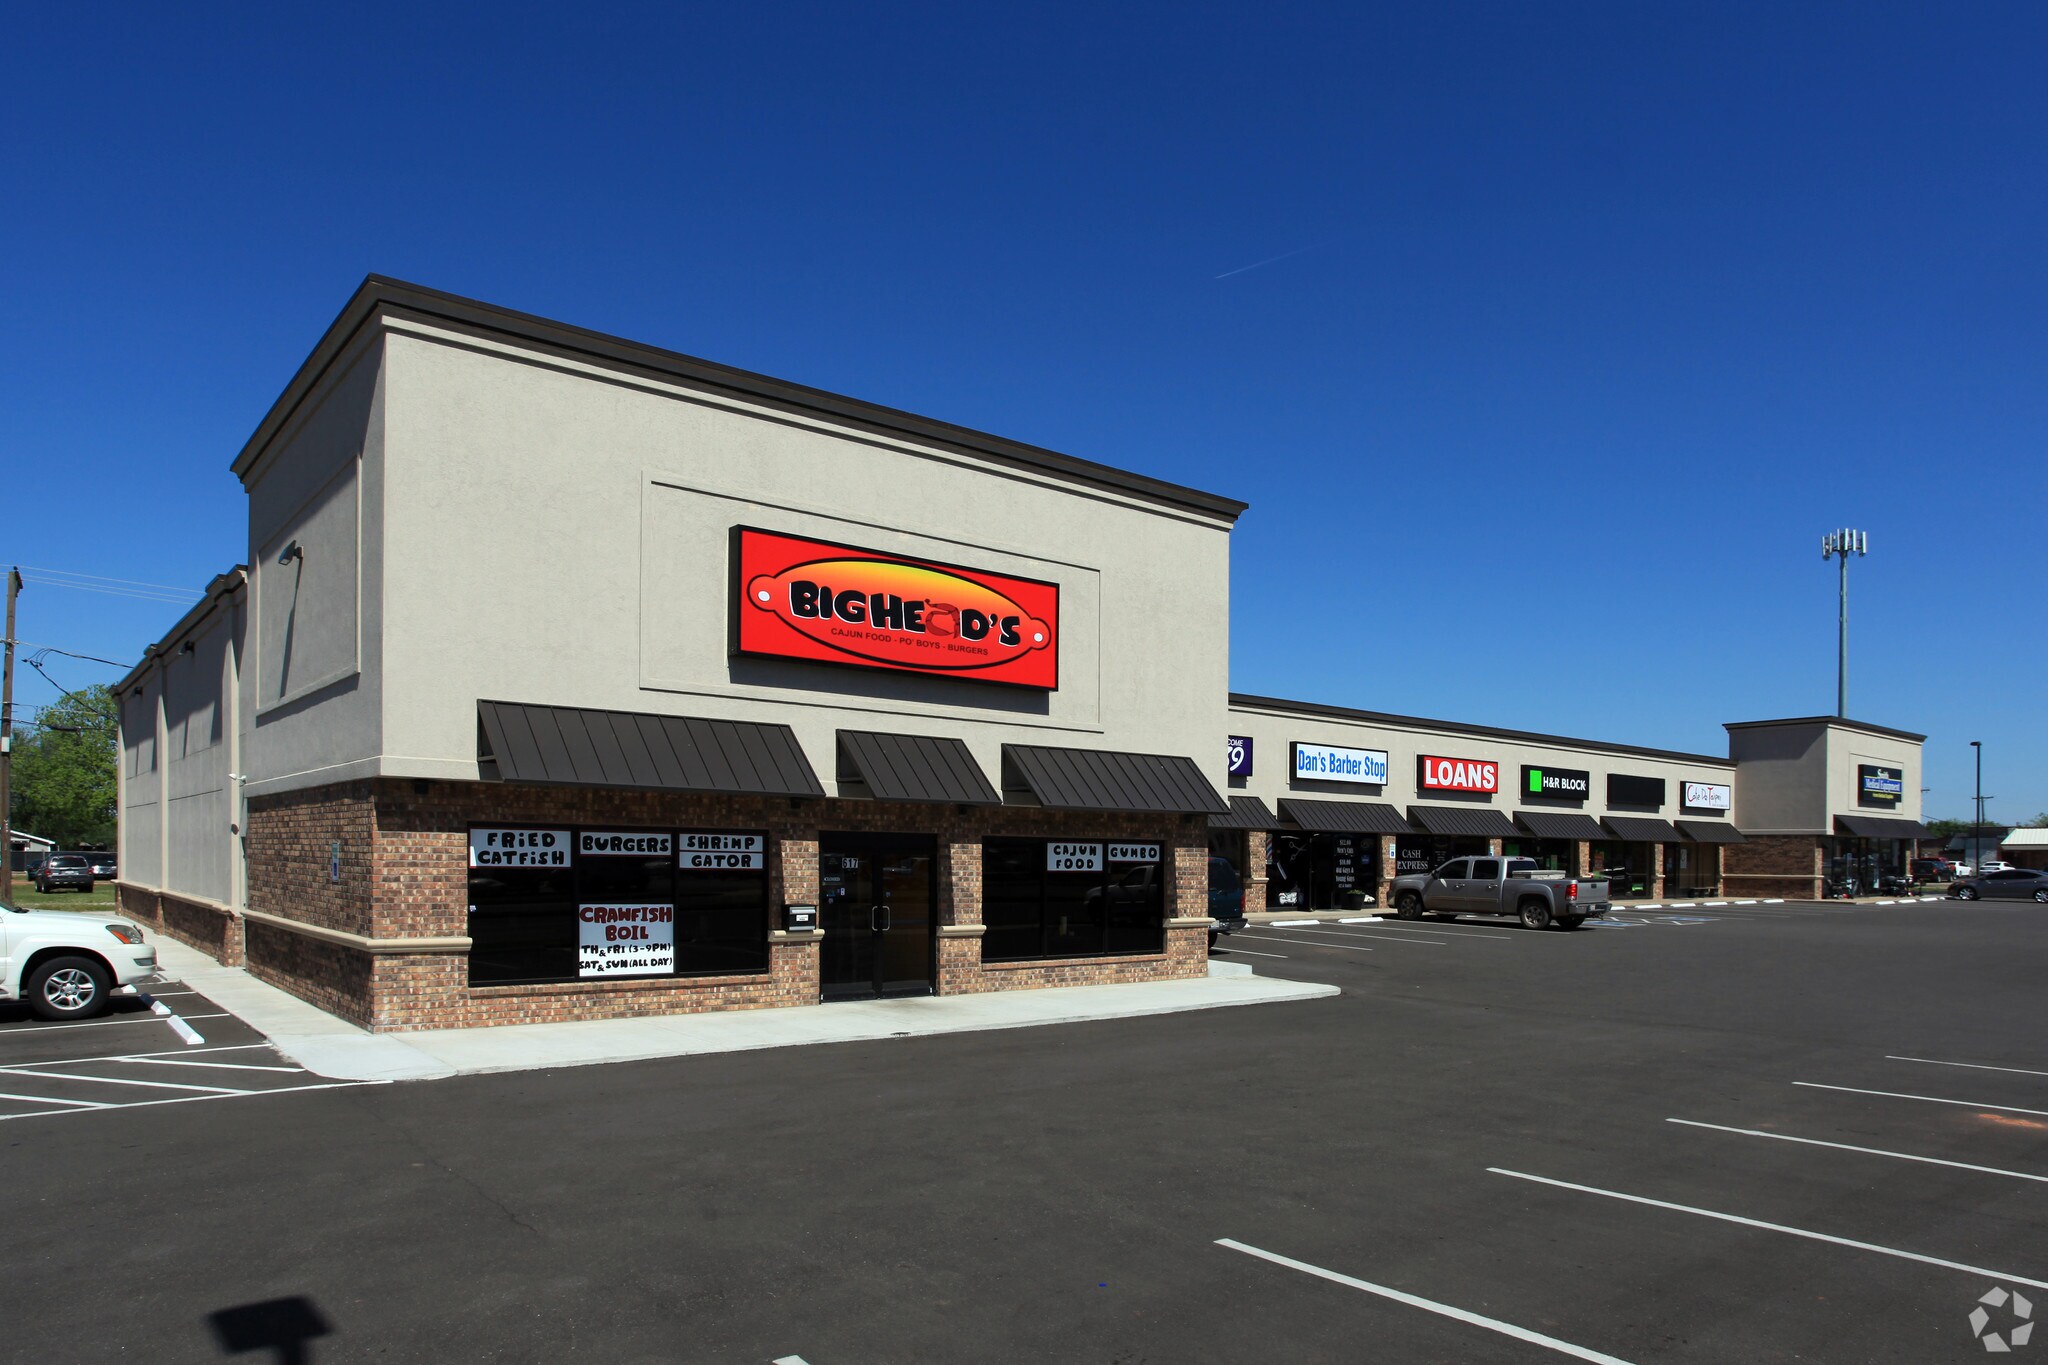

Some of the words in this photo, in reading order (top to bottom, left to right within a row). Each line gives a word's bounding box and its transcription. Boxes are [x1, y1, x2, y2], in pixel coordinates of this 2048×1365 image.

[831, 627, 863, 639] CAJUN
[865, 632, 892, 643] FOOD
[916, 640, 941, 649] BOYS
[947, 643, 989, 656] BURGERS
[1298, 749, 1327, 773] Dan's
[1329, 752, 1362, 775] Barber
[1364, 755, 1386, 782] Stop
[1425, 759, 1495, 789] LOANS
[1543, 776, 1560, 789] H&R
[1561, 778, 1587, 791] BLOCK
[582, 835, 669, 853] BURGERS
[1053, 845, 1097, 857] CAJUN
[1110, 847, 1158, 859] GUMBO
[1402, 849, 1421, 859] CASH
[691, 854, 752, 868] GATOR
[842, 857, 858, 869] 617
[1056, 858, 1094, 870] FOOD
[1397, 860, 1429, 870] EXPRESS
[579, 907, 673, 924] CRAWFISH
[605, 925, 649, 941] BOIL
[581, 944, 599, 954] TH
[607, 944, 625, 954] FRI
[579, 960, 599, 970] SAT
[605, 959, 628, 969] SUN
[629, 959, 648, 968] (ALL
[650, 957, 673, 967] DAY)
